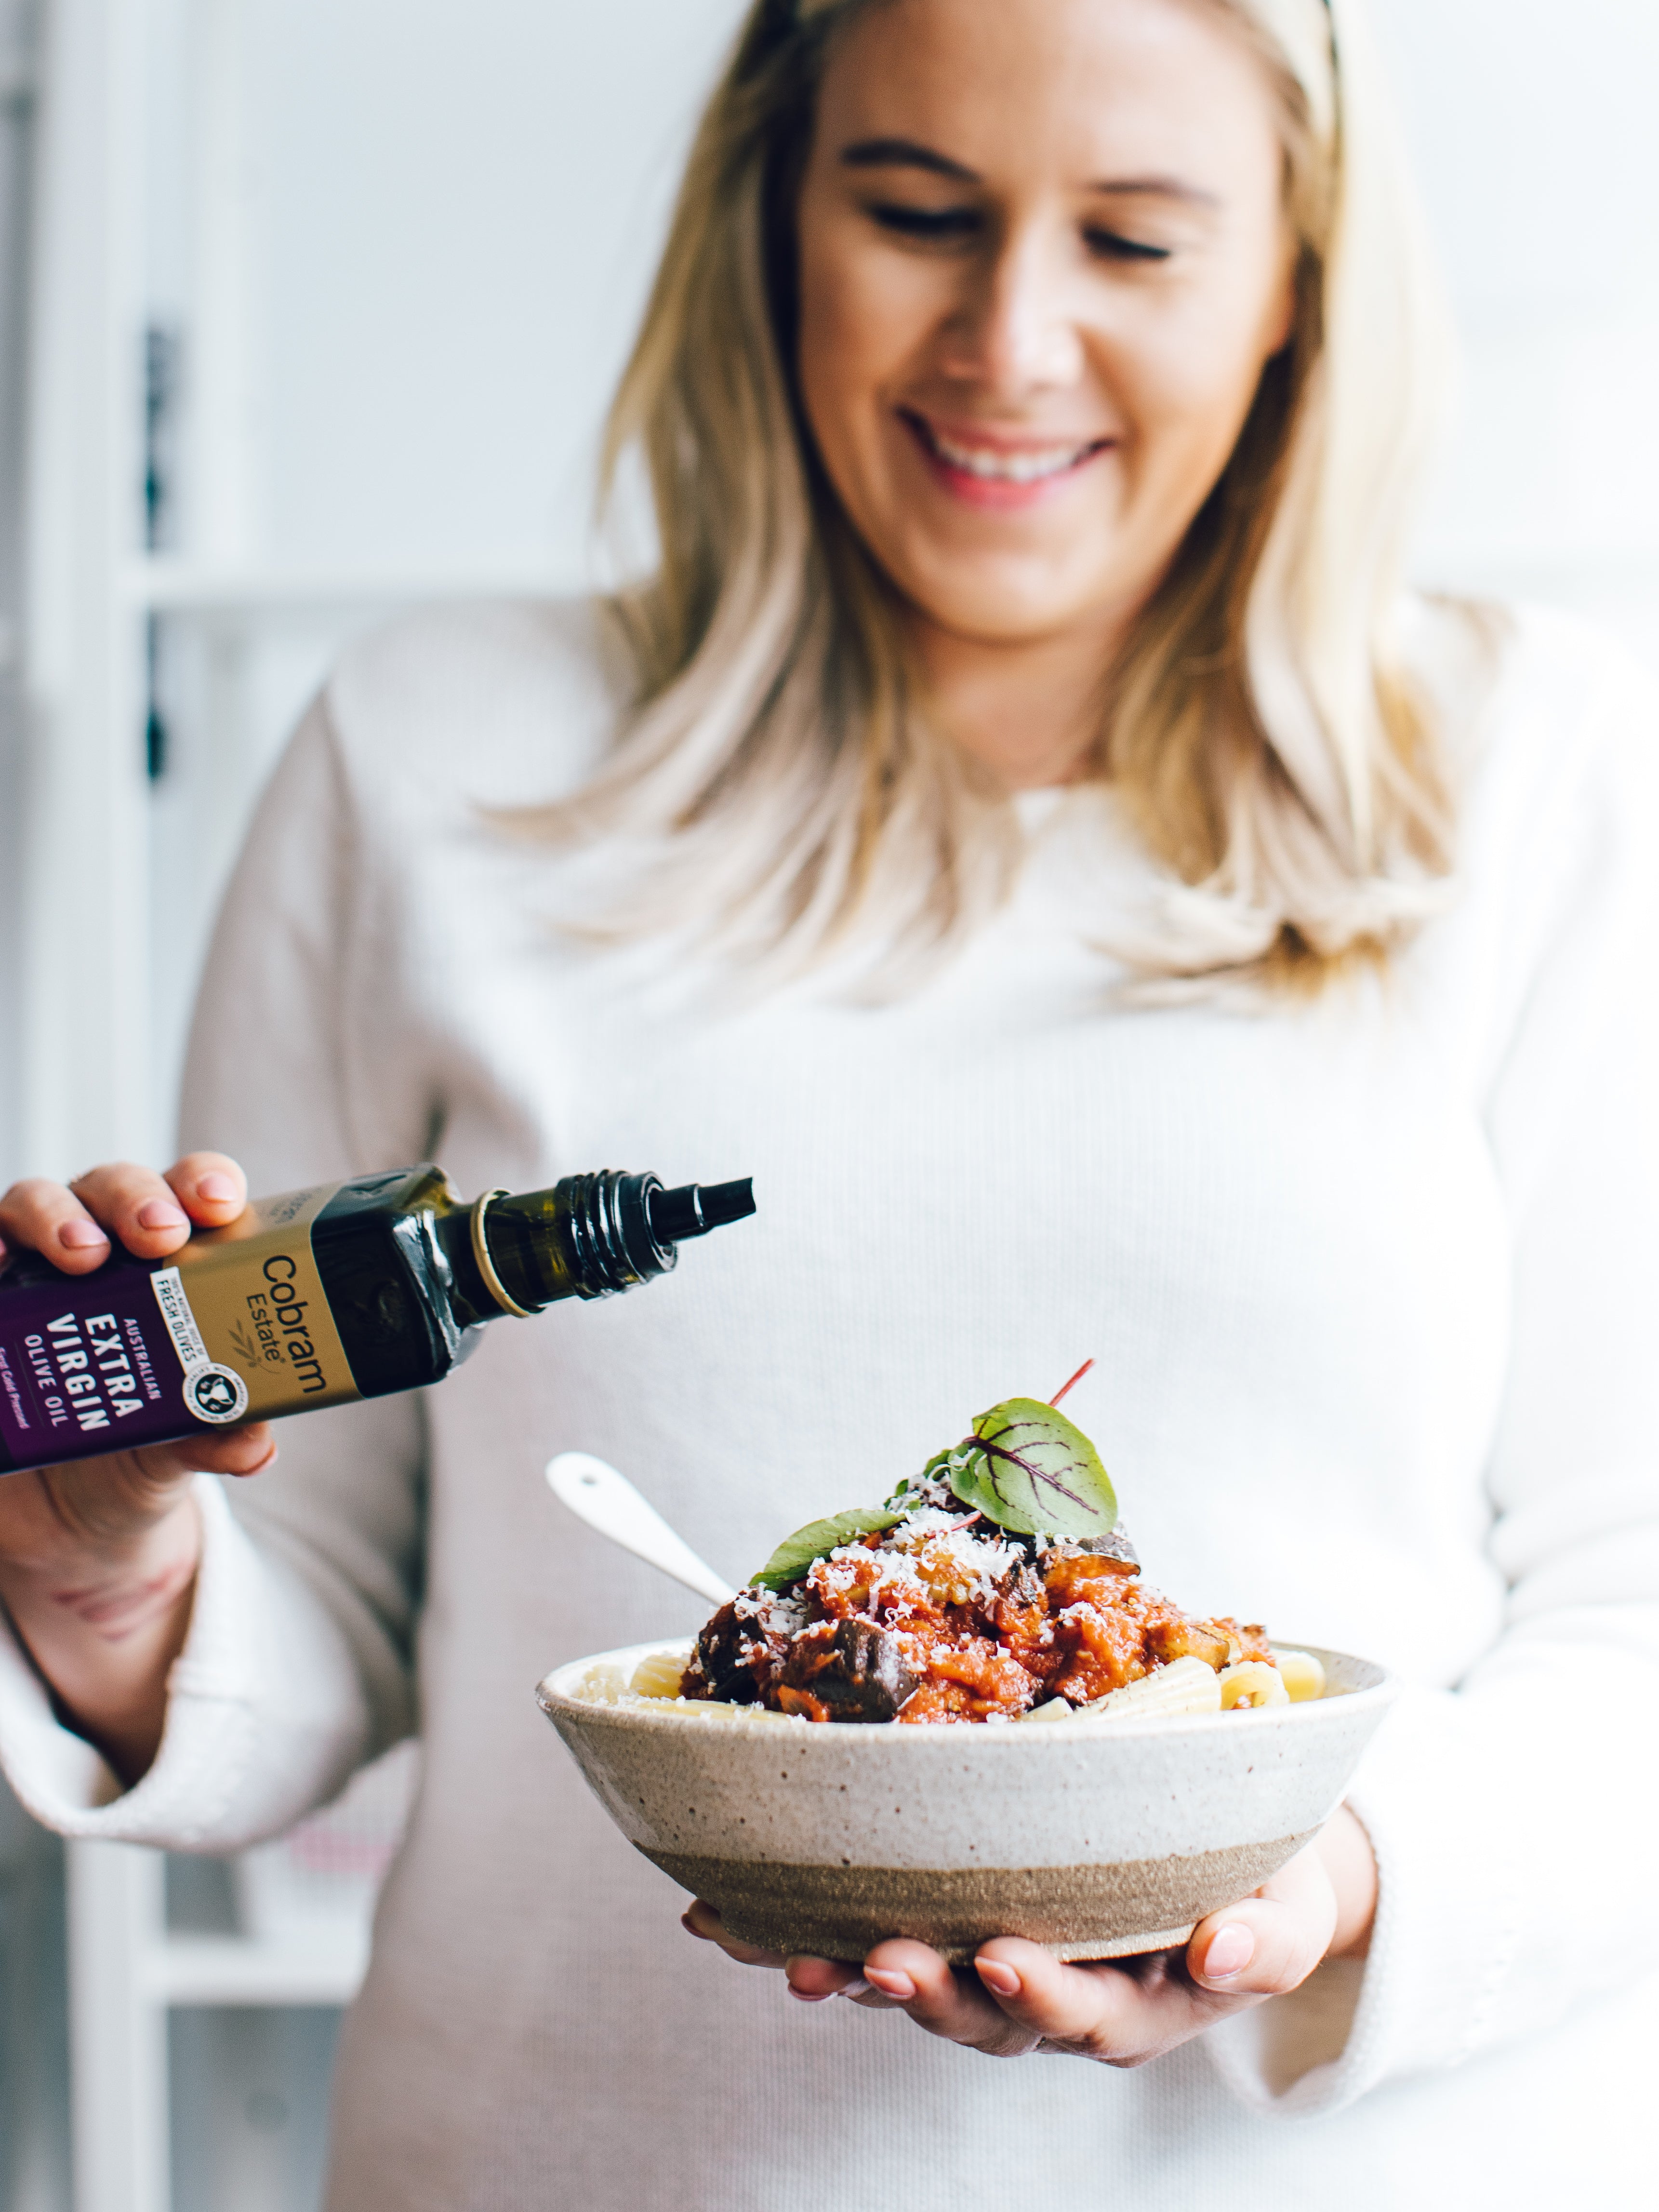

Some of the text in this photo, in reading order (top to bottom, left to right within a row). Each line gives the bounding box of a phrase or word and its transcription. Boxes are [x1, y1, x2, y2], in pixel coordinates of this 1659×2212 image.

[85, 1313, 144, 1417] EXTRA
[123, 1318, 162, 1400] AUSTRALIAN
[157, 1279, 197, 1362] FRESH OLIVES
[246, 1293, 281, 1362] Estate
[263, 1255, 327, 1393] Cobram
[25, 1334, 69, 1427] OLIVE OIL
[47, 1312, 111, 1431] VIRGIN
